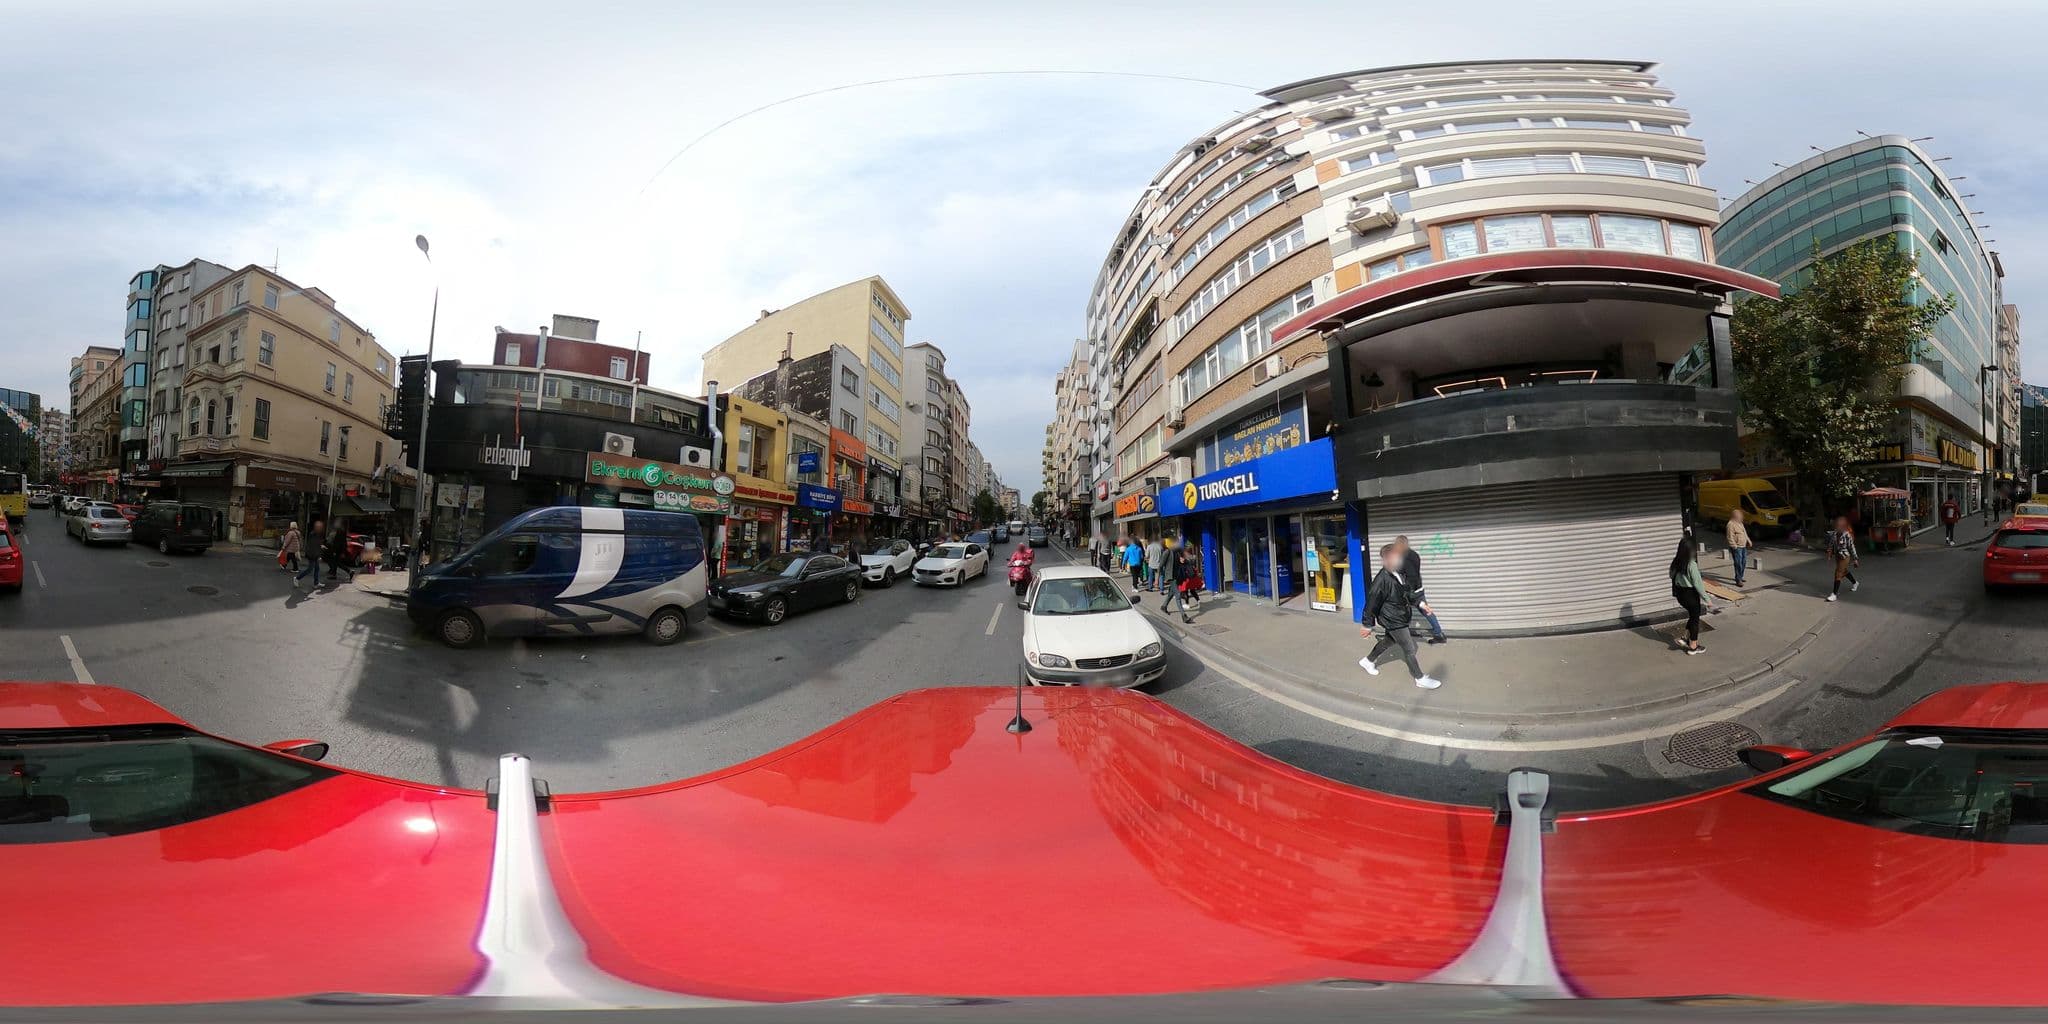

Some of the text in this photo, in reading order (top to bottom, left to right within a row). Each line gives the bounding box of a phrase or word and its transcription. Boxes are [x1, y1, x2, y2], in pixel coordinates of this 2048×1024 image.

[591, 459, 642, 480] Ekrem
[663, 470, 713, 490] Coşkun
[1198, 472, 1259, 501] TURKCELL
